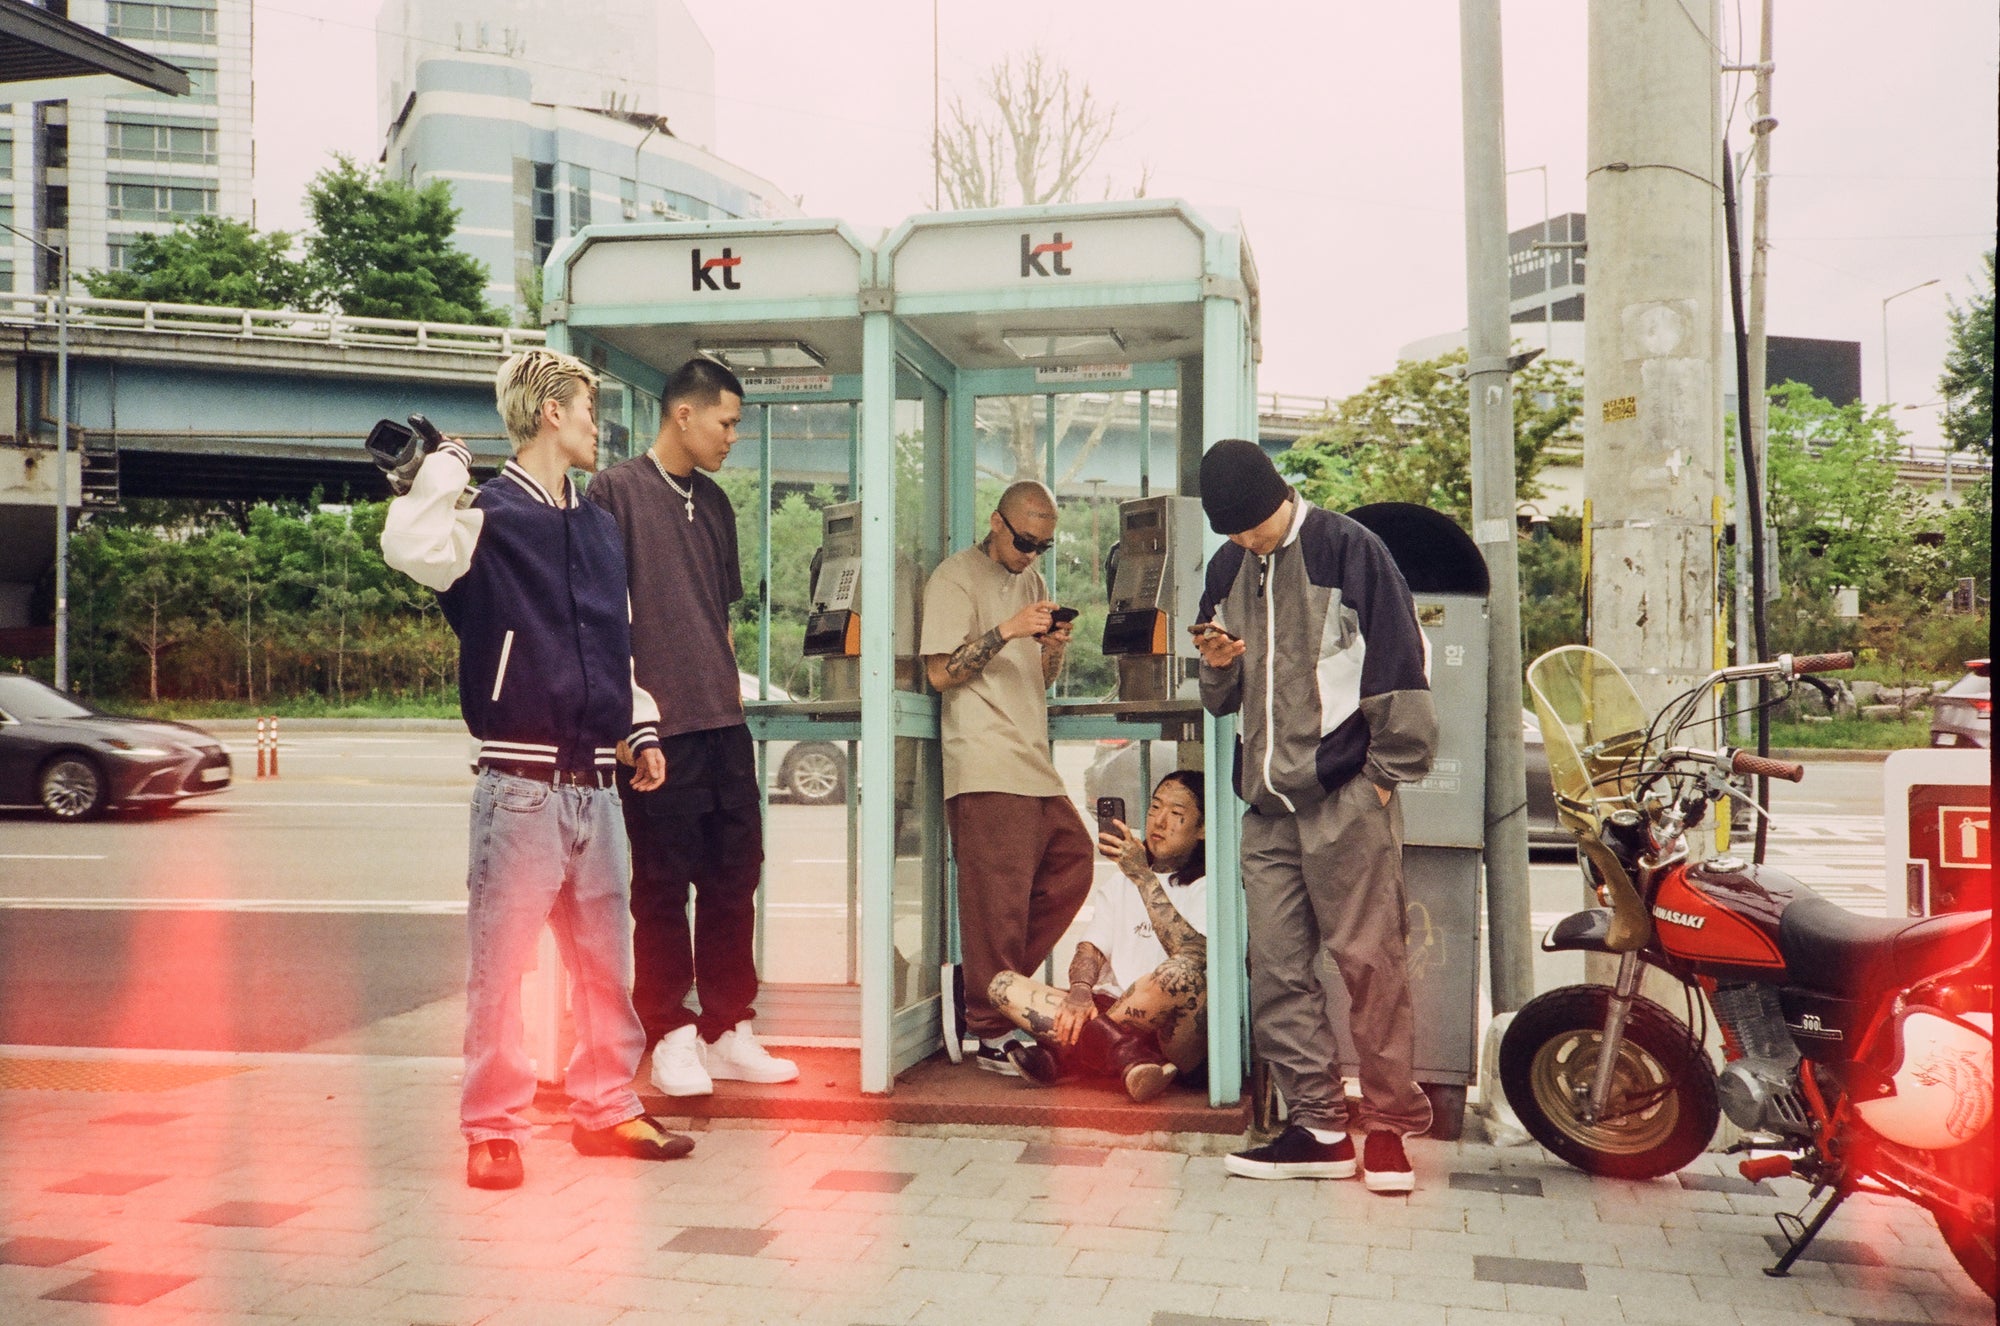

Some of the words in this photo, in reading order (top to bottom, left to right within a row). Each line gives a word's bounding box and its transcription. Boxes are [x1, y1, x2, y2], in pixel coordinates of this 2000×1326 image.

[691, 247, 742, 291] kt
[1021, 232, 1073, 277] kt
[1444, 645, 1465, 666] 함
